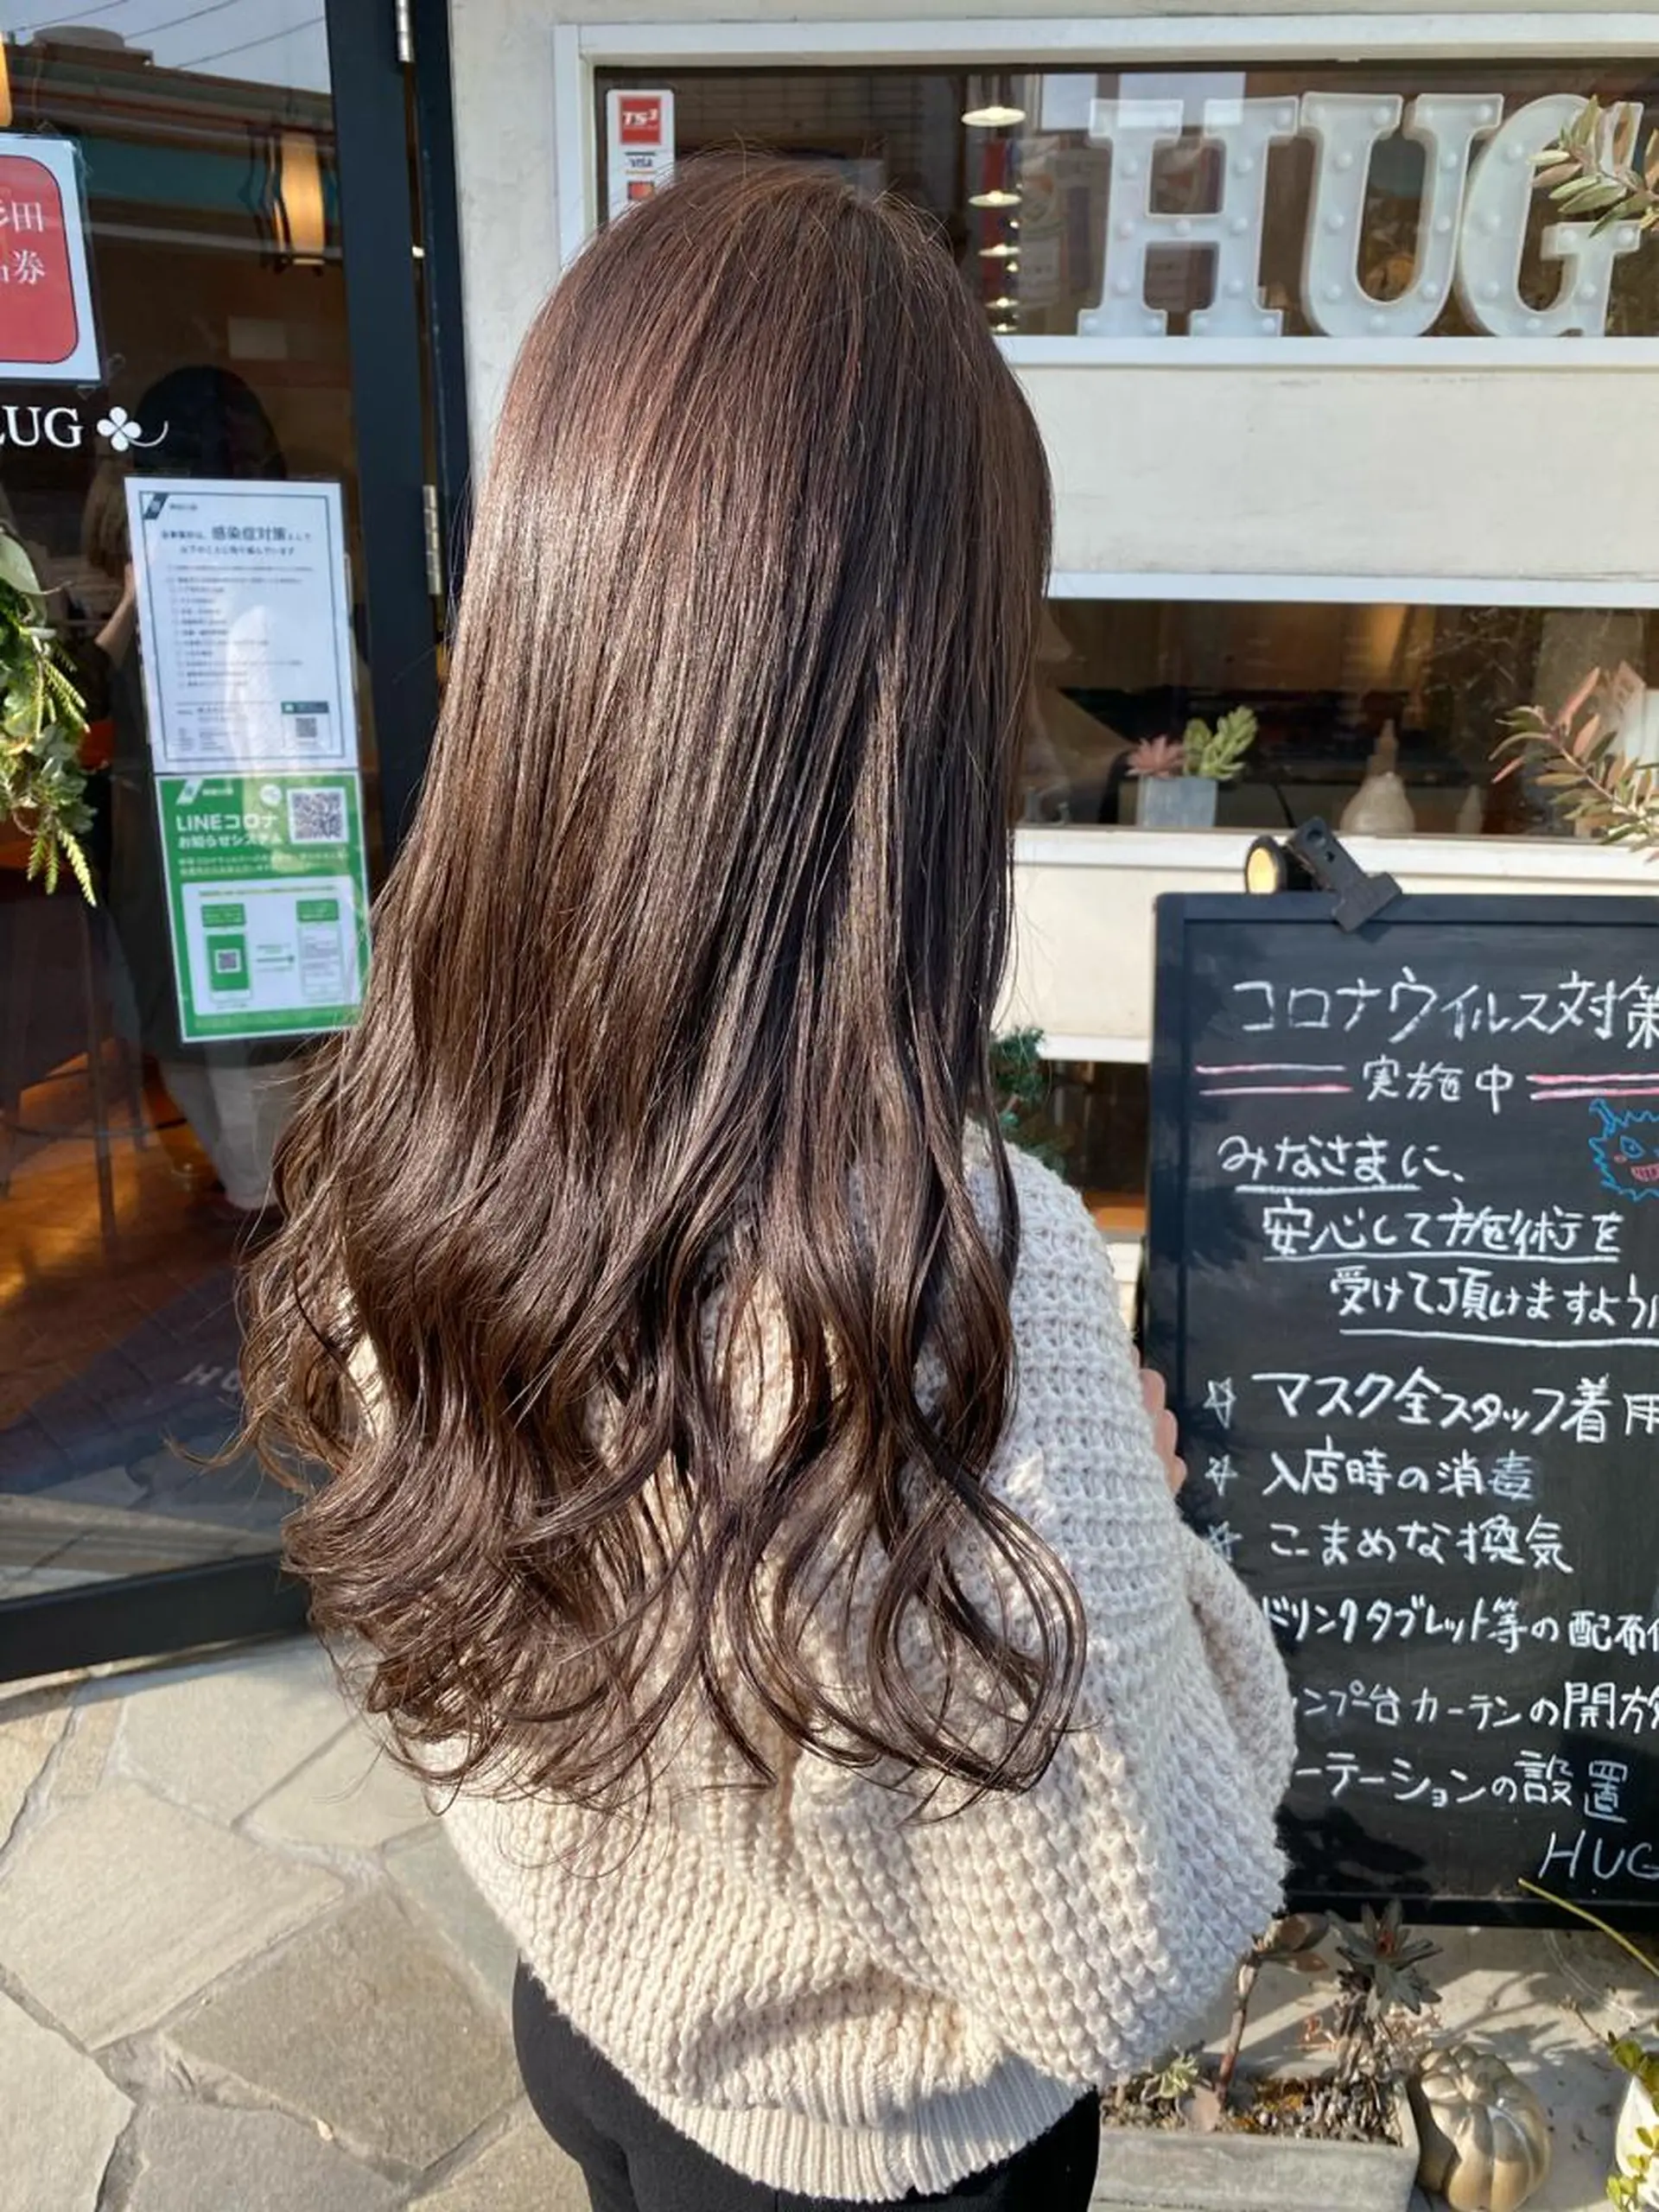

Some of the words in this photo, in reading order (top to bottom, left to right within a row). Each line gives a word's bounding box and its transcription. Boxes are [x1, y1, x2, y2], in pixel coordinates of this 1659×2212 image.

[1077, 92, 1643, 337] HUG
[0, 249, 46, 285] 券
[0, 405, 84, 448] UG
[1363, 1055, 1514, 1114] 実施中
[1217, 1134, 1465, 1183] みなさまに、
[1262, 1197, 1624, 1255] 安心して施術を
[1330, 1265, 1659, 1331] 受けて頂けますよう
[1262, 1435, 1534, 1501] 入店時の消毒
[1269, 1513, 1574, 1573] こまめな換気
[1293, 1679, 1659, 1734] ンプー台カーテンの開放
[1538, 1827, 1659, 1880] HUG
